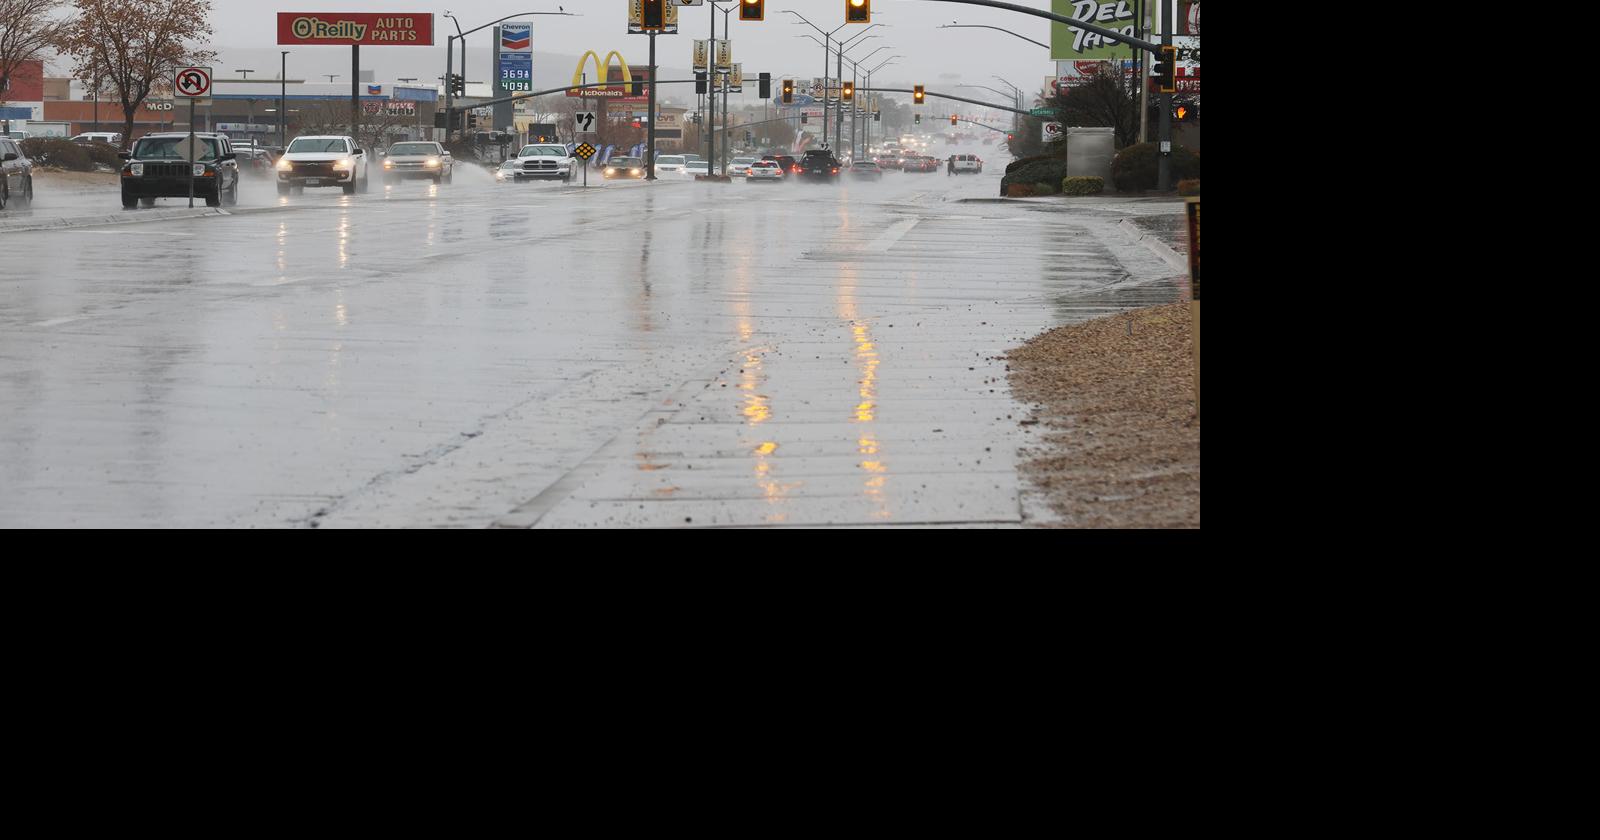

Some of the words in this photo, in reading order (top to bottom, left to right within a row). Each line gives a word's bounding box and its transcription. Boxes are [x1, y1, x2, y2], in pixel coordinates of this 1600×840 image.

[1071, 0, 1132, 23] DEL
[376, 17, 413, 28] AUTO
[292, 17, 367, 41] O'Reilly
[371, 30, 417, 41] PARTS
[580, 89, 624, 97] McDonald's
[146, 102, 175, 111] McD
